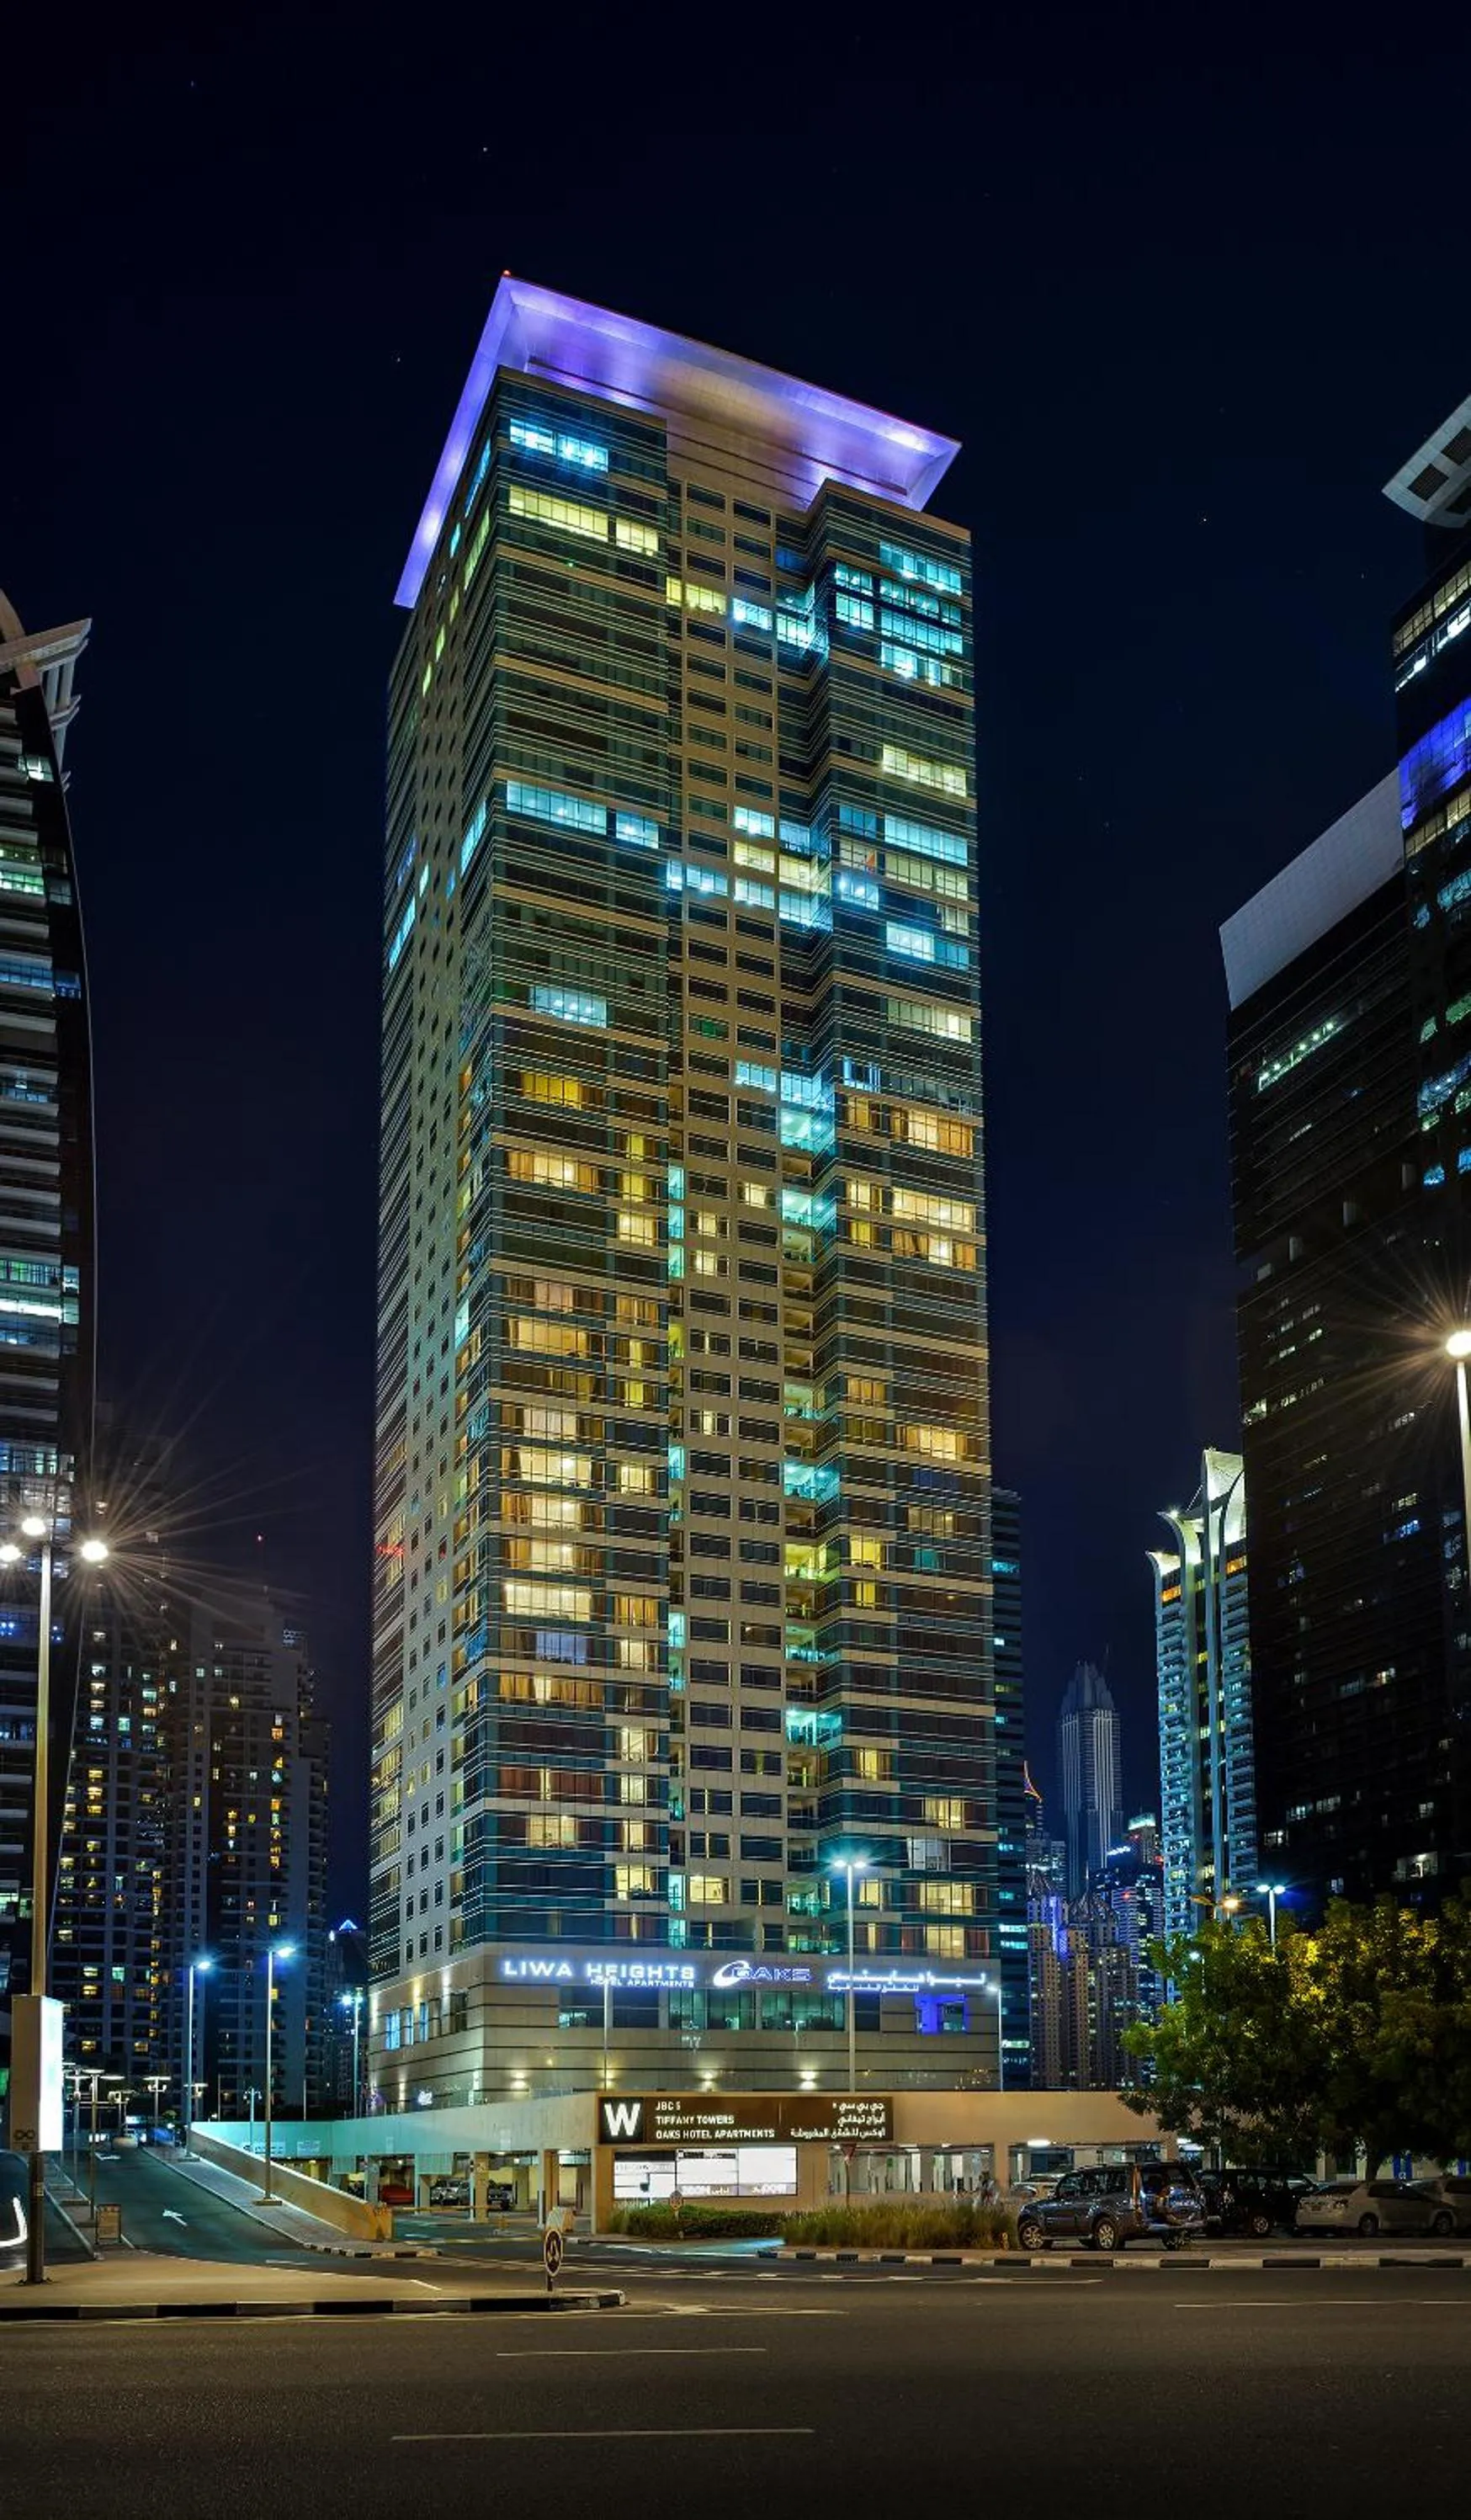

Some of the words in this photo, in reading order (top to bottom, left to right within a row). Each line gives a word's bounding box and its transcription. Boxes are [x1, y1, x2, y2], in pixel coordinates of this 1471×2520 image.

[505, 1960, 573, 1977] LIWA
[588, 1962, 694, 1980] HEIGHTS
[591, 1977, 622, 1986] HOTEL
[628, 1979, 694, 1988] APARTMENTS
[656, 2102, 674, 2111] JBC
[604, 2103, 640, 2136] W
[656, 2115, 694, 2125] TIFFANY
[697, 2114, 735, 2124] TOWERS
[656, 2129, 681, 2140] OAKS
[682, 2129, 712, 2140] HOTEL
[714, 2129, 775, 2139] APARTMENTS
